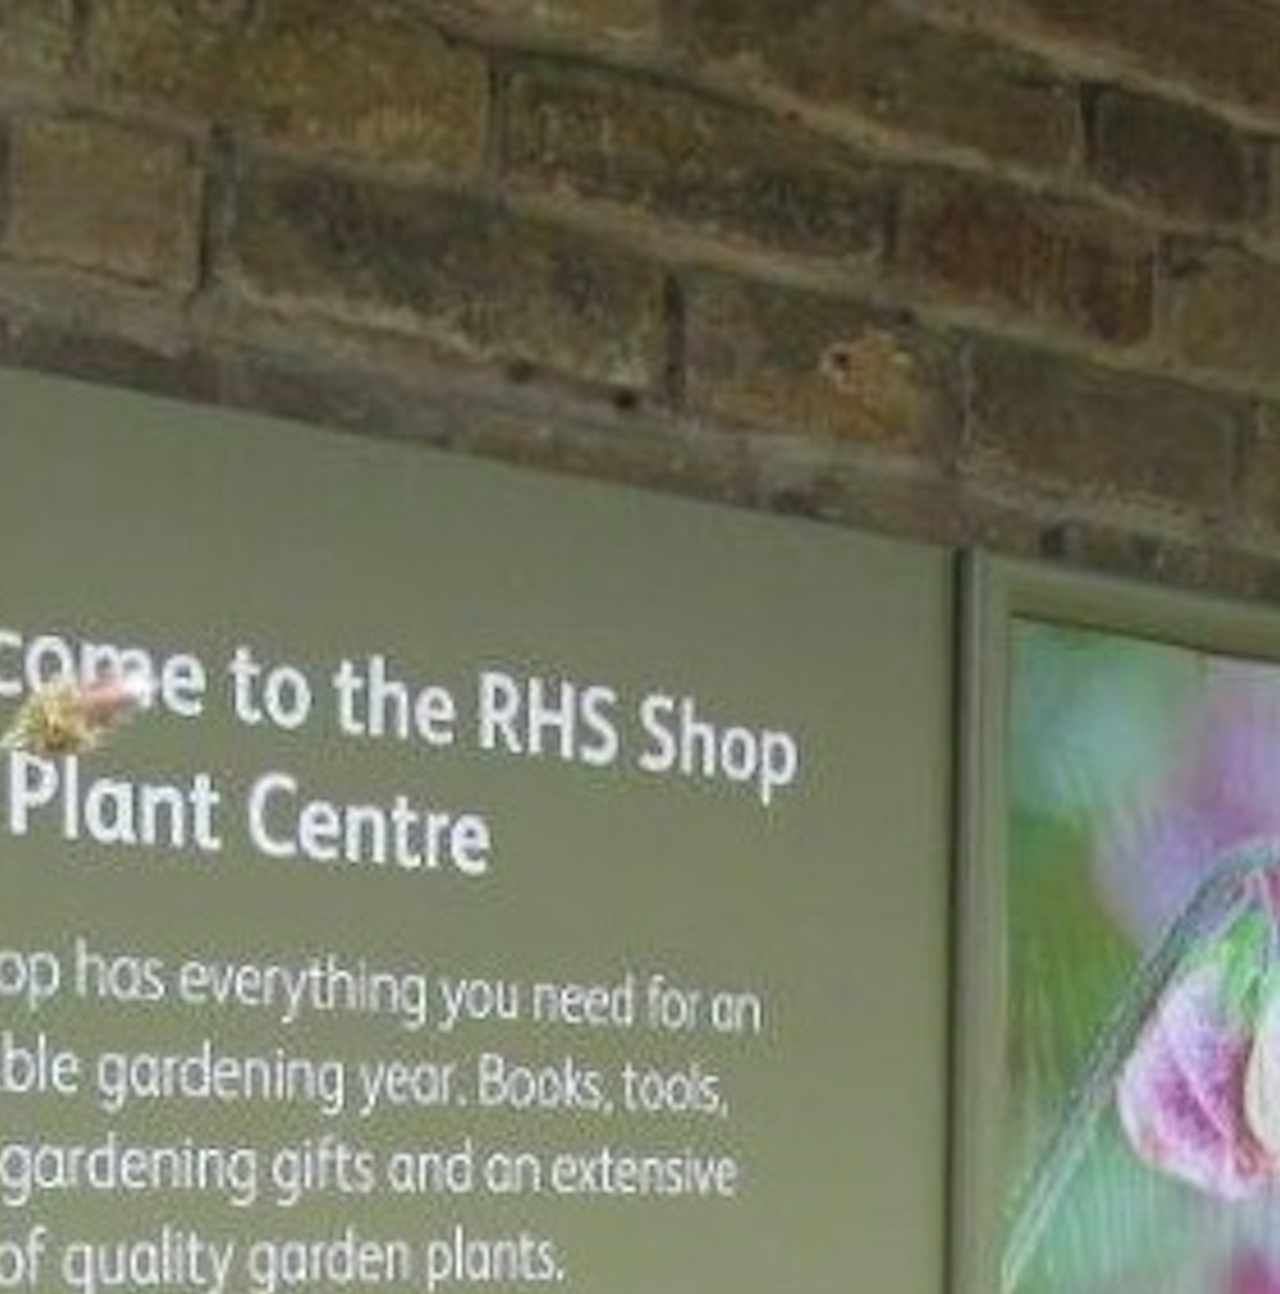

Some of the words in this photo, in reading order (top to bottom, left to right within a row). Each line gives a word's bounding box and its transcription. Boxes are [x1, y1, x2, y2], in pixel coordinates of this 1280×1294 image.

[233, 645, 311, 729] to
[333, 656, 454, 748] the
[478, 671, 619, 768] RHS
[638, 695, 798, 805] Shop
[9, 750, 220, 852] Plant
[248, 772, 492, 875] Centre
[75, 938, 166, 1000] has
[179, 956, 428, 1028] everything
[439, 970, 518, 1030] you
[533, 975, 634, 1026] need
[648, 976, 699, 1028] for
[710, 987, 763, 1035] an
[98, 1041, 344, 1112] gardening
[359, 1059, 466, 1116] year.
[478, 1052, 613, 1116] Books,
[622, 1059, 729, 1119] tools,
[273, 1136, 374, 1207] gifts
[390, 1140, 472, 1194] and
[486, 1151, 540, 1194] an
[551, 1145, 737, 1198] extensive
[426, 1224, 565, 1291] plants.
